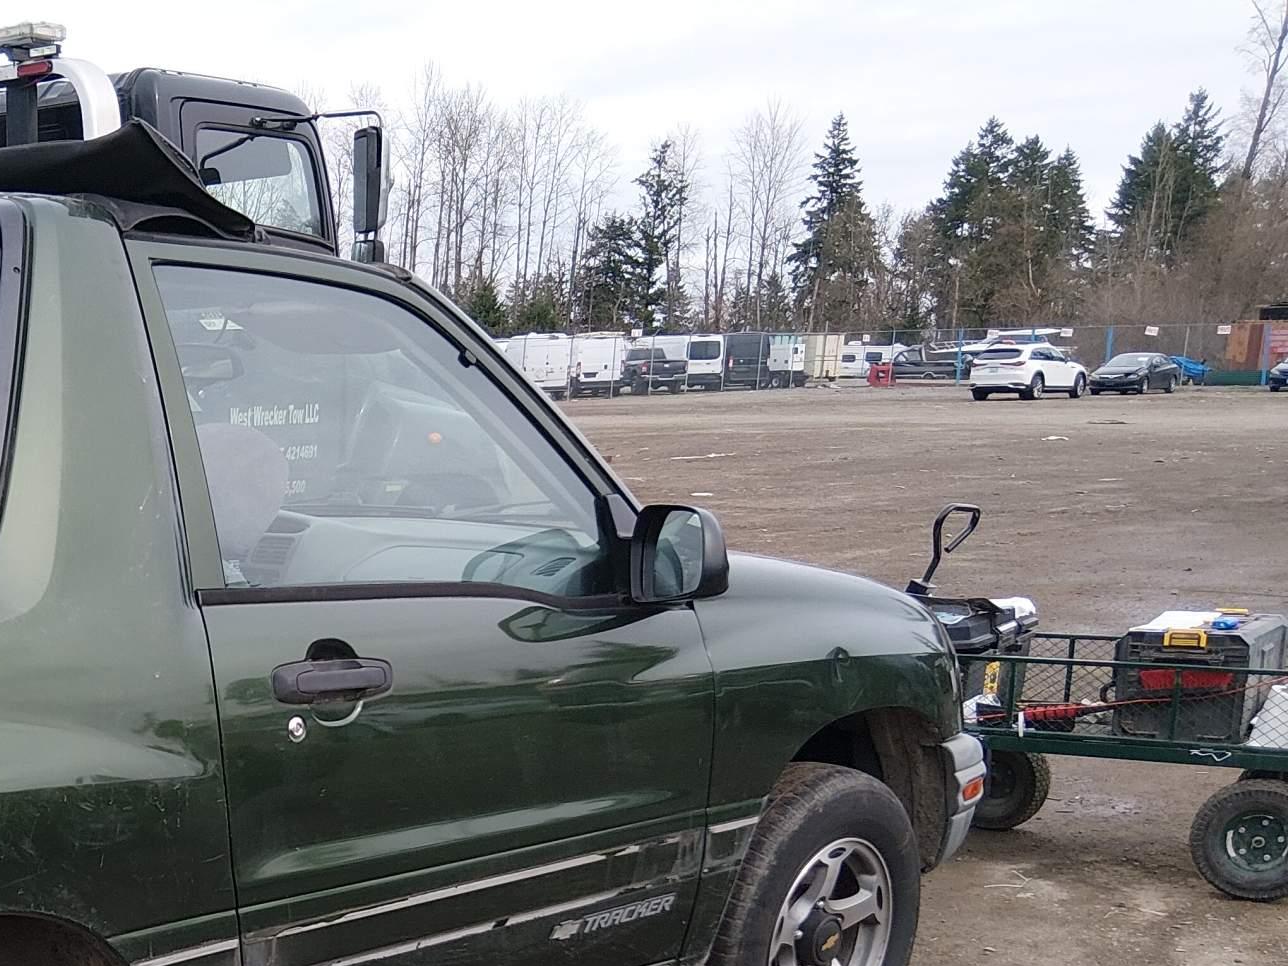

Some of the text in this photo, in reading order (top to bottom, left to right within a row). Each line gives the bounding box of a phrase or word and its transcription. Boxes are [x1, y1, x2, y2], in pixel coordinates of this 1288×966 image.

[229, 403, 320, 427] West Wrecker Tow LLC
[584, 895, 676, 933] TRACKER
